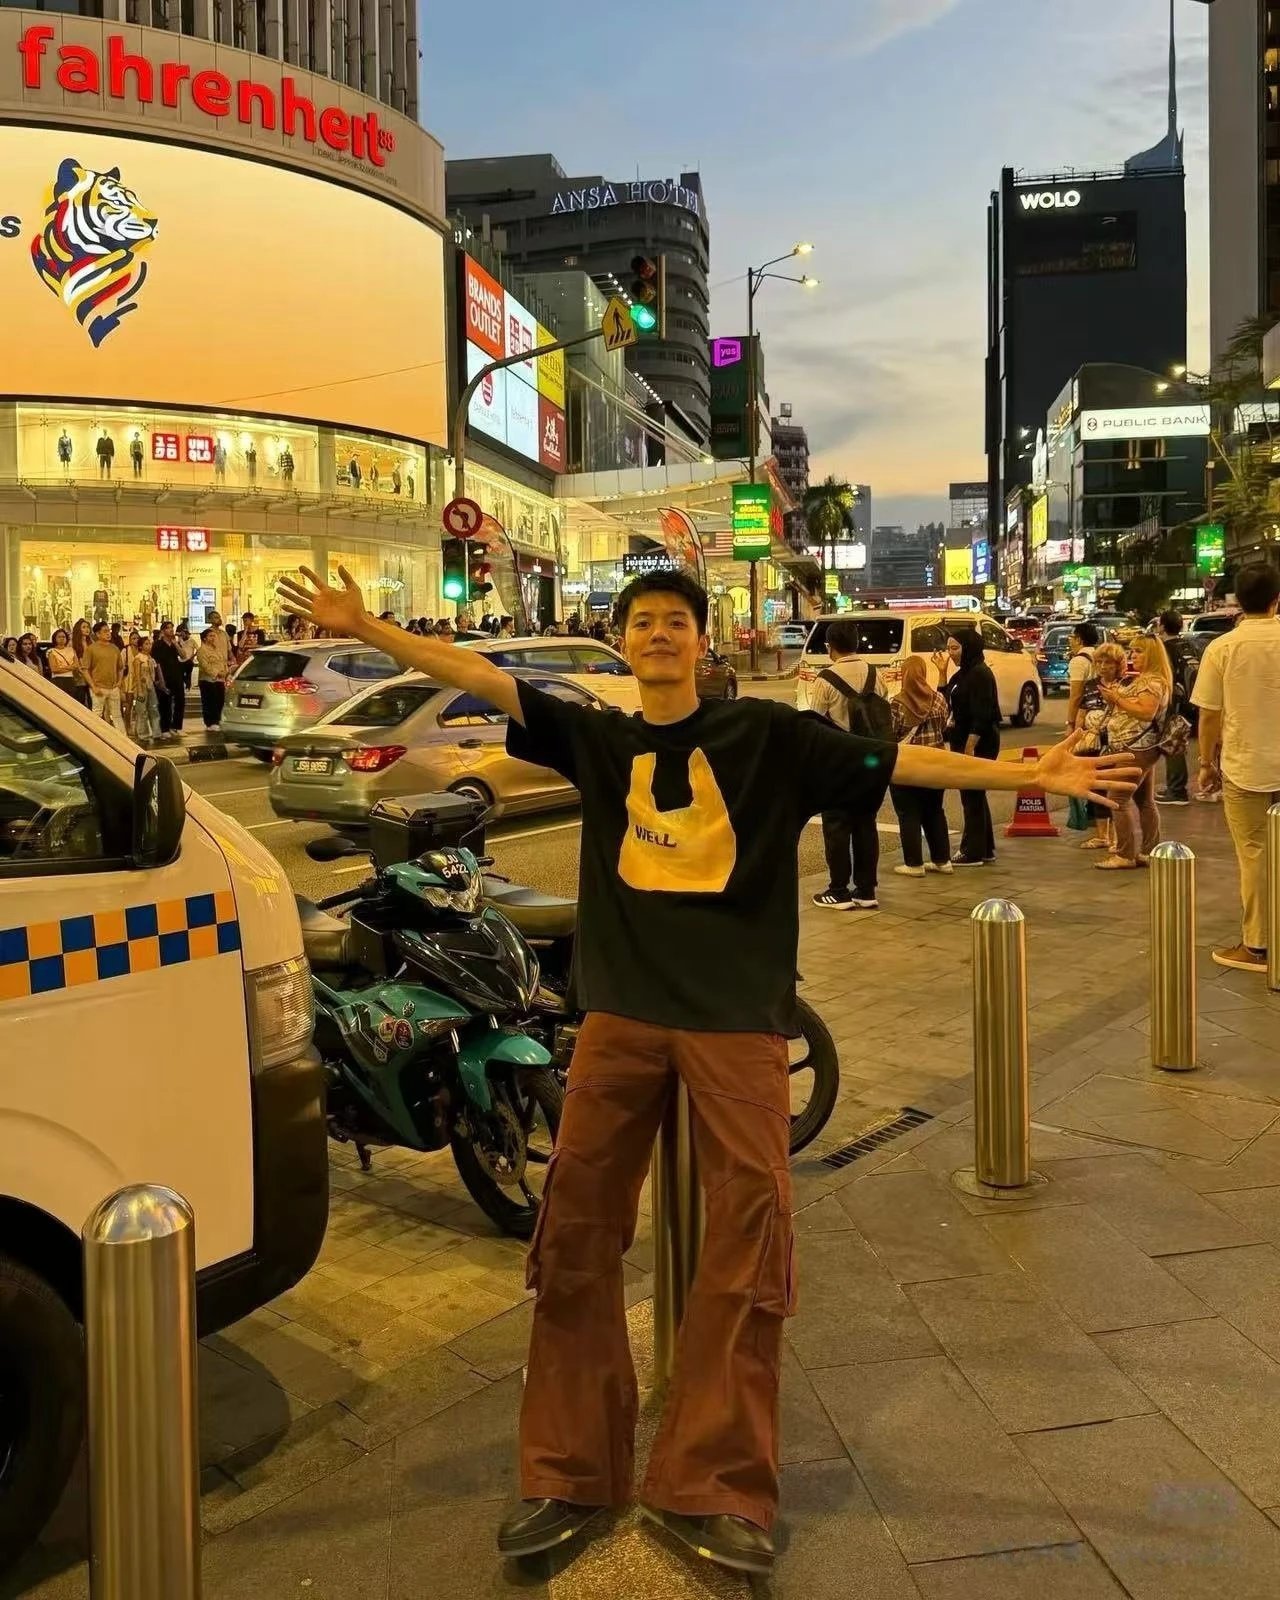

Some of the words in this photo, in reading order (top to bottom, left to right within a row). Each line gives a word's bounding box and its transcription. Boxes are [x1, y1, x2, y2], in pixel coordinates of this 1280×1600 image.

[550, 184, 619, 215] ANSA
[1020, 189, 1081, 210] WOLO
[468, 274, 501, 323] BRANDS
[470, 301, 501, 347] OUTLET
[720, 347, 736, 357] yes
[1103, 418, 1157, 428] PUBLIC
[1162, 415, 1208, 426] BANK
[188, 438, 209, 450] UNI
[188, 450, 211, 461] QLO
[1021, 798, 1042, 806] POLIS
[635, 824, 678, 848] WELL
[442, 863, 469, 879] 5422
